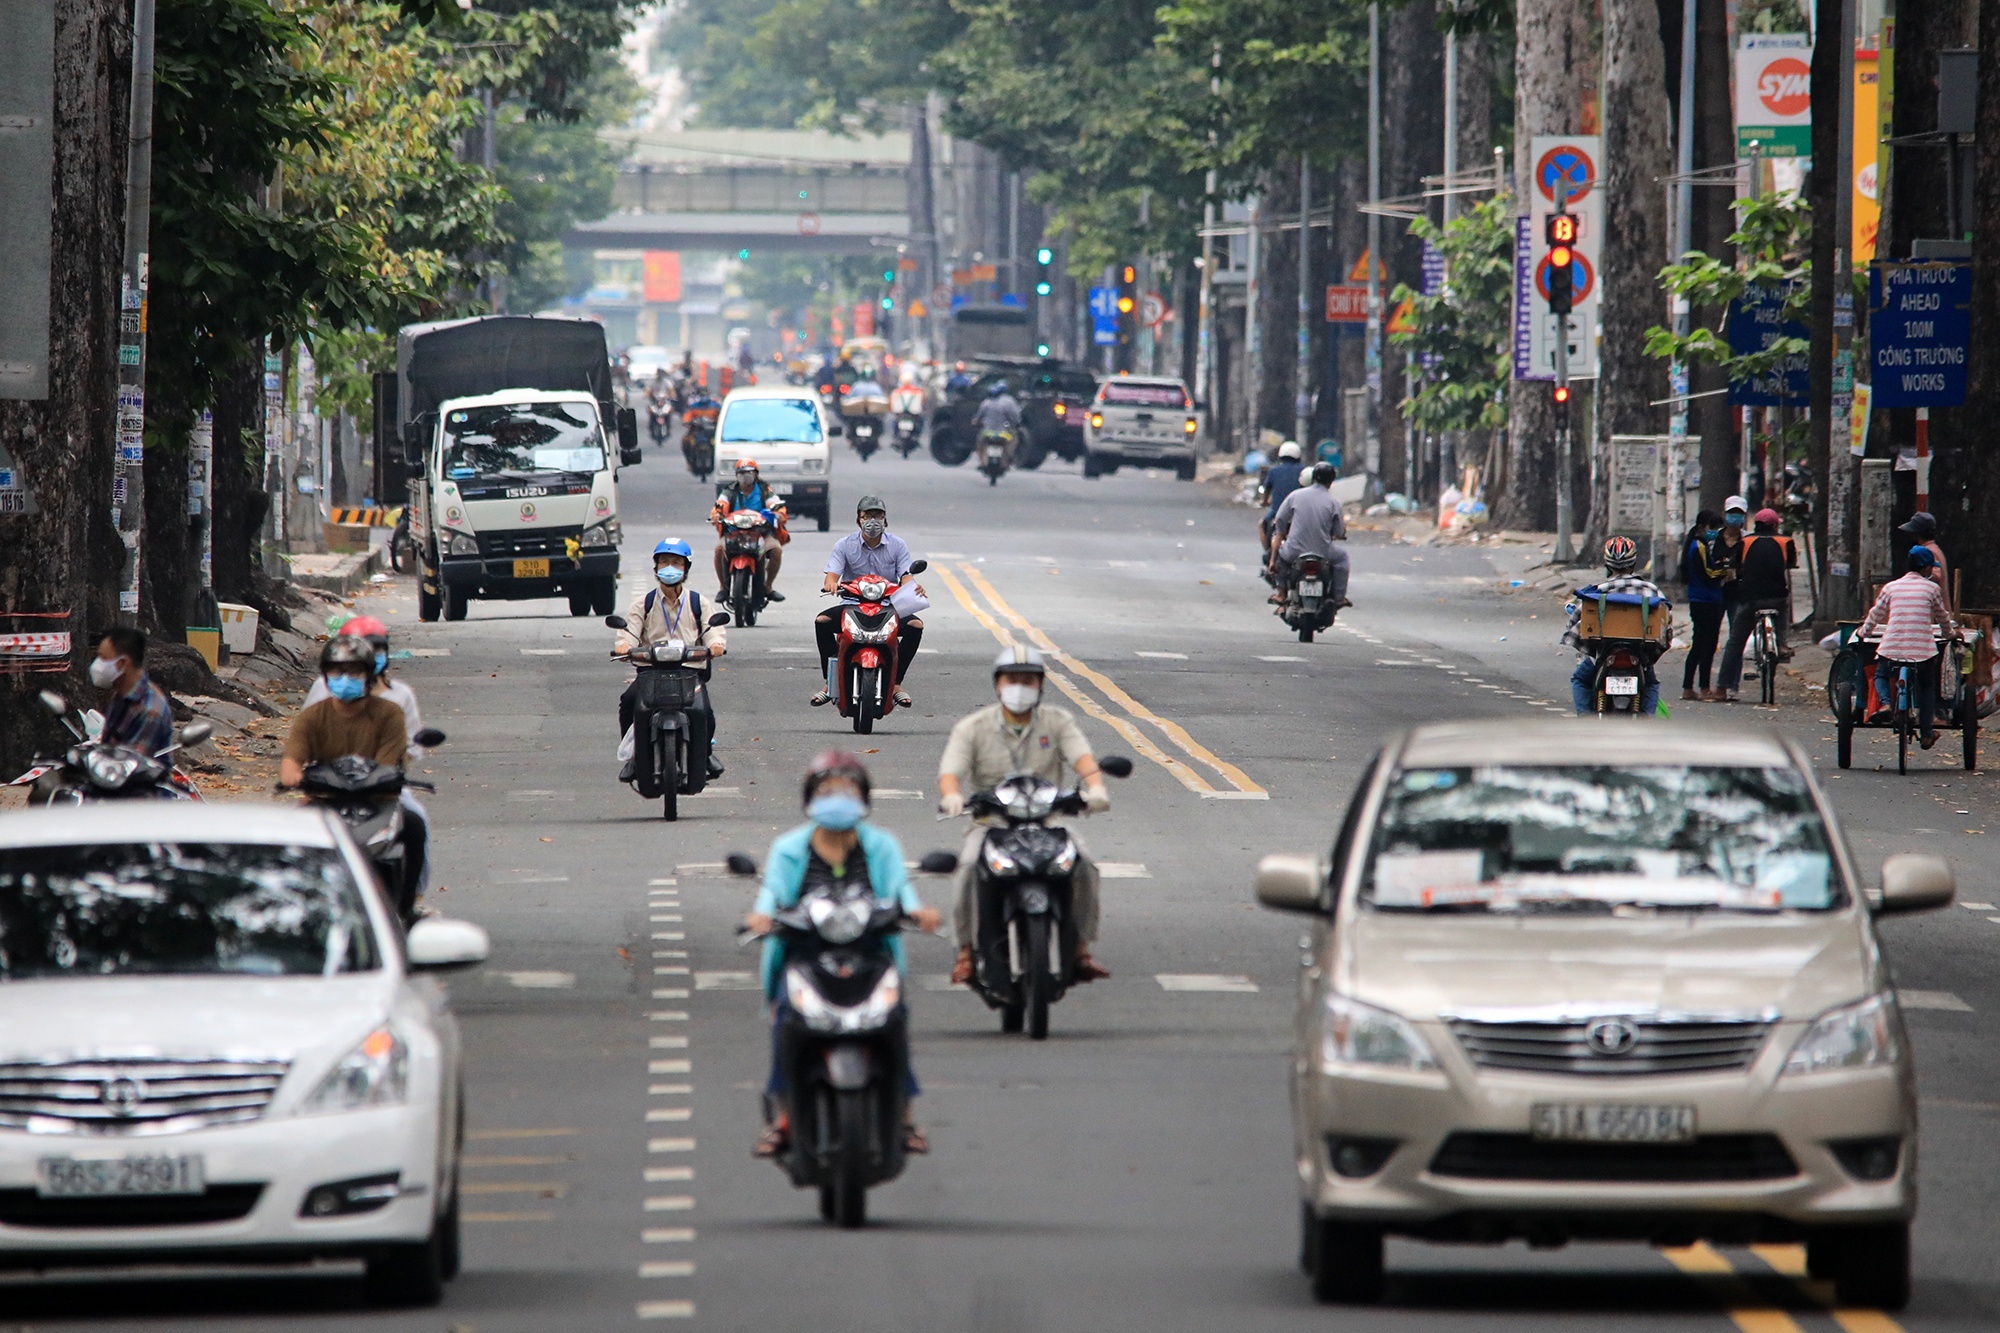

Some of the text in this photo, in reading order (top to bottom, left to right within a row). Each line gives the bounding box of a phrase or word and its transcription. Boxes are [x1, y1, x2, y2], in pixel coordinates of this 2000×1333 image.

[1759, 73, 1811, 102] SYM
[1900, 293, 1940, 311] AHEAD
[1904, 321, 1934, 338] 100M
[1878, 345, 1912, 366] CÔNG
[1901, 373, 1945, 392] WORKS
[506, 486, 547, 498] ISUZU
